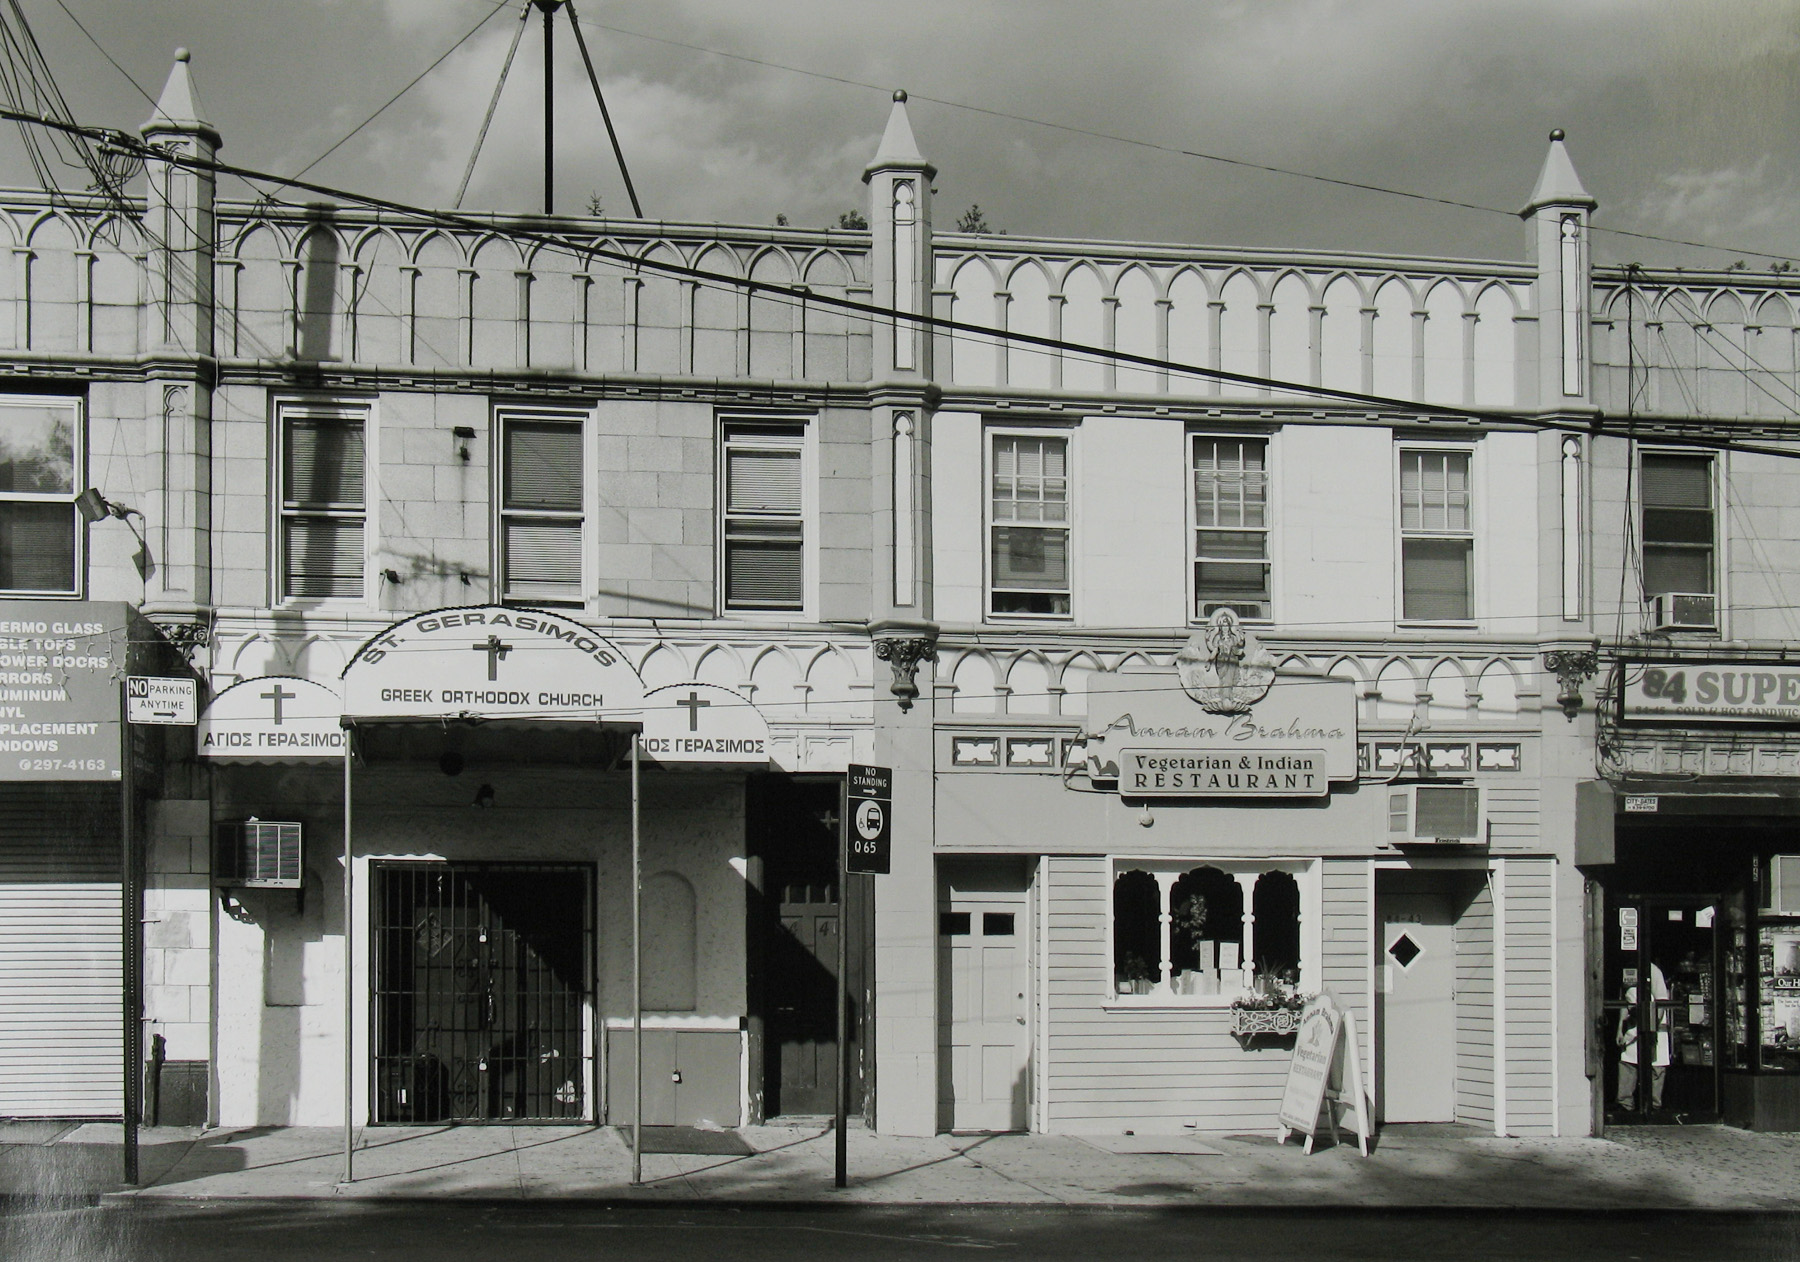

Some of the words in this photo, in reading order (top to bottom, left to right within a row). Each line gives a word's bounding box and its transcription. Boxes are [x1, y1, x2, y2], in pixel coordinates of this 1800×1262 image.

[0, 622, 47, 634] ERMO
[52, 622, 104, 635] GLASS
[34, 639, 76, 651] TOPS
[363, 634, 406, 664] ST.
[416, 613, 617, 667] GERASIMOS
[0, 656, 48, 668] OWER
[53, 656, 109, 668] DOORS
[0, 673, 53, 685] RRORS
[129, 680, 148, 696] NO
[149, 685, 192, 696] PARKING
[1641, 668, 1687, 705] 84
[1695, 671, 1800, 706] SUPE
[0, 690, 66, 701] UMINUM
[381, 688, 433, 703] GREEK
[441, 690, 530, 705] ORTHODOX
[538, 692, 603, 707] CHURCH
[140, 700, 185, 710] ANYTIME
[1721, 707, 1742, 716] HOT
[1747, 708, 1799, 717] SANDWIC
[0, 723, 99, 735] PLACEMENT
[1104, 713, 1217, 738] Annam
[1224, 711, 1345, 741] Brahma
[203, 732, 253, 747] ΑΓΙΟΣ
[0, 740, 59, 752] NDOWS
[675, 738, 765, 754] ΓΕΡΑΣΙΜΟΣ
[33, 759, 106, 771] 297-4163
[1135, 755, 1231, 773] Vegetarian
[1239, 757, 1251, 769] &
[1258, 756, 1313, 769] Indian
[865, 767, 876, 776] NO
[853, 776, 887, 788] STANDING
[1135, 773, 1315, 788] RESTAURANT
[854, 840, 861, 853] Q
[863, 841, 877, 854] 65
[1778, 978, 1792, 987] Our
